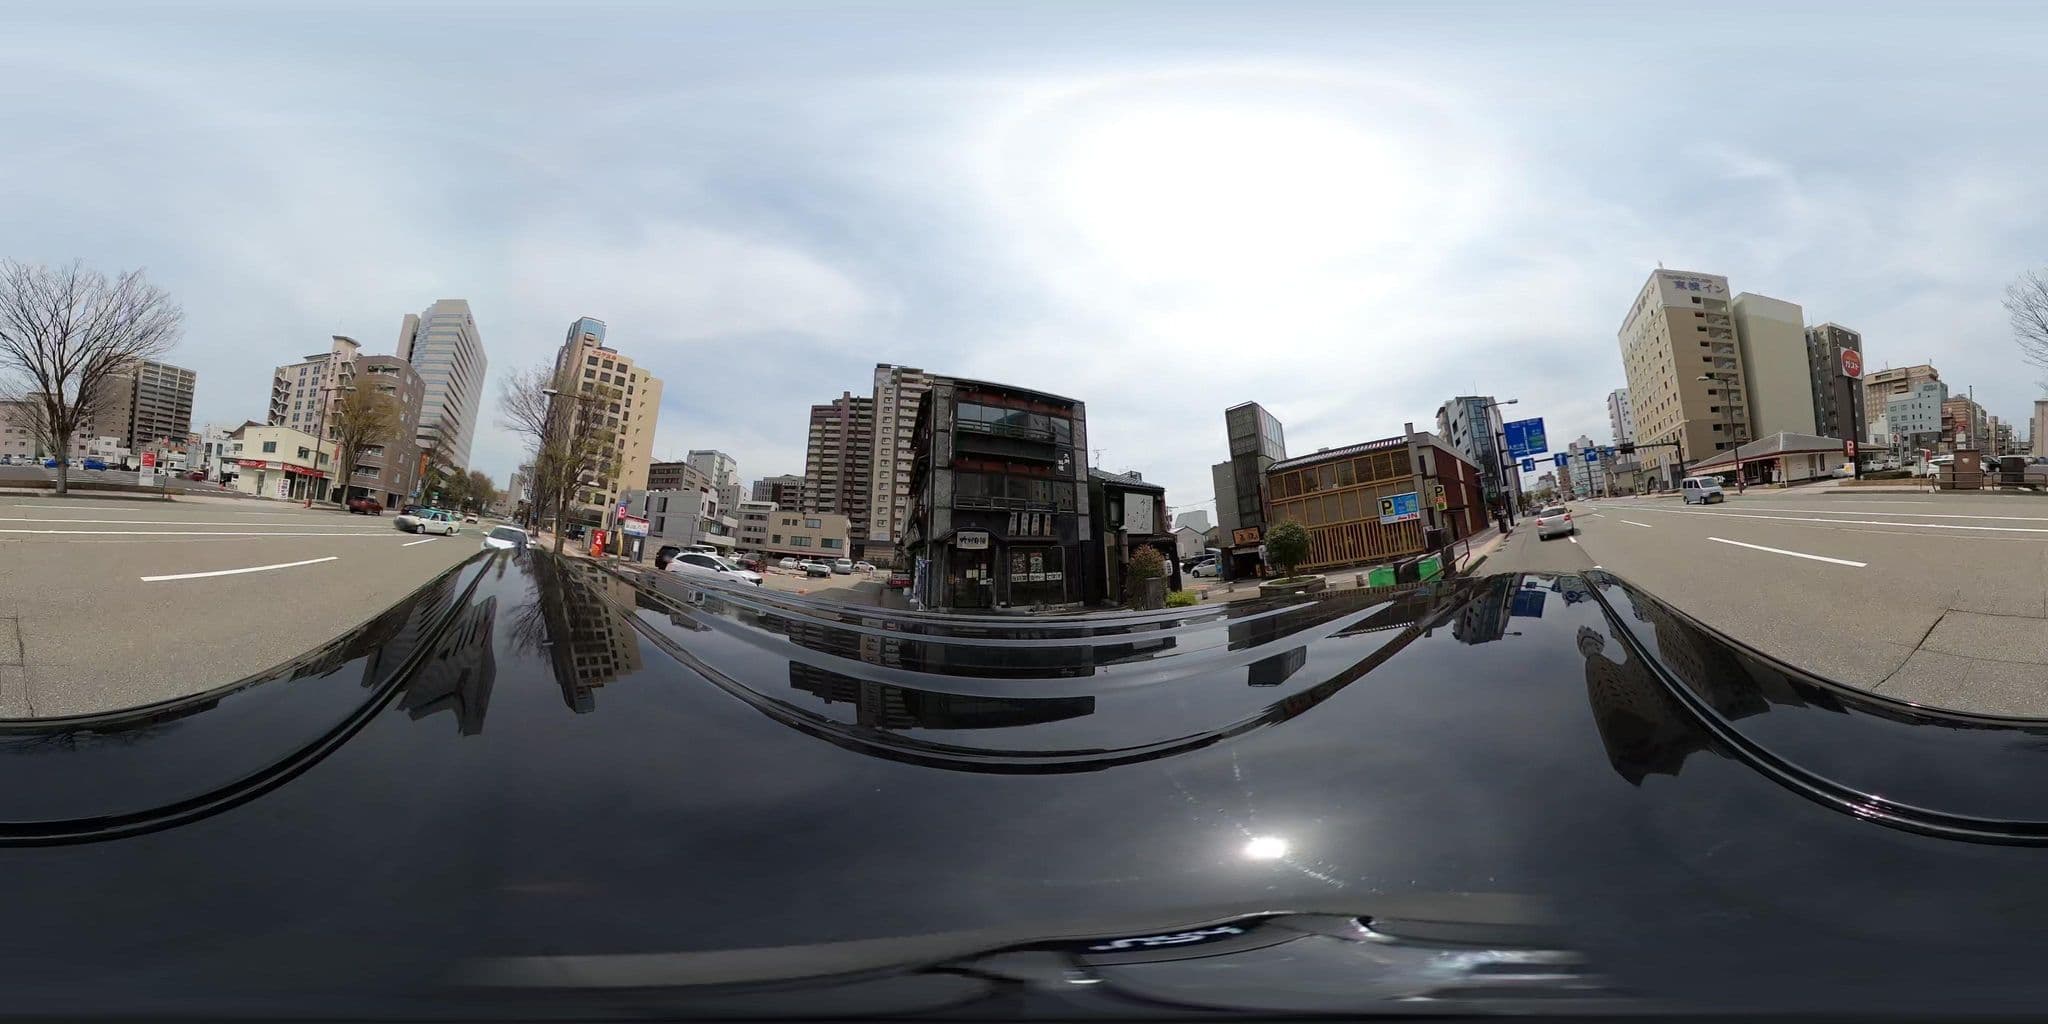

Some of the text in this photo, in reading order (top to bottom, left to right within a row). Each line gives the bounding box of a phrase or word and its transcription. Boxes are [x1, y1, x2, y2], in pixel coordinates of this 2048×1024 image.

[1672, 279, 1726, 293] 東横イン
[1845, 359, 1860, 370] ガスト
[1434, 486, 1443, 497] P
[1381, 500, 1392, 515] P
